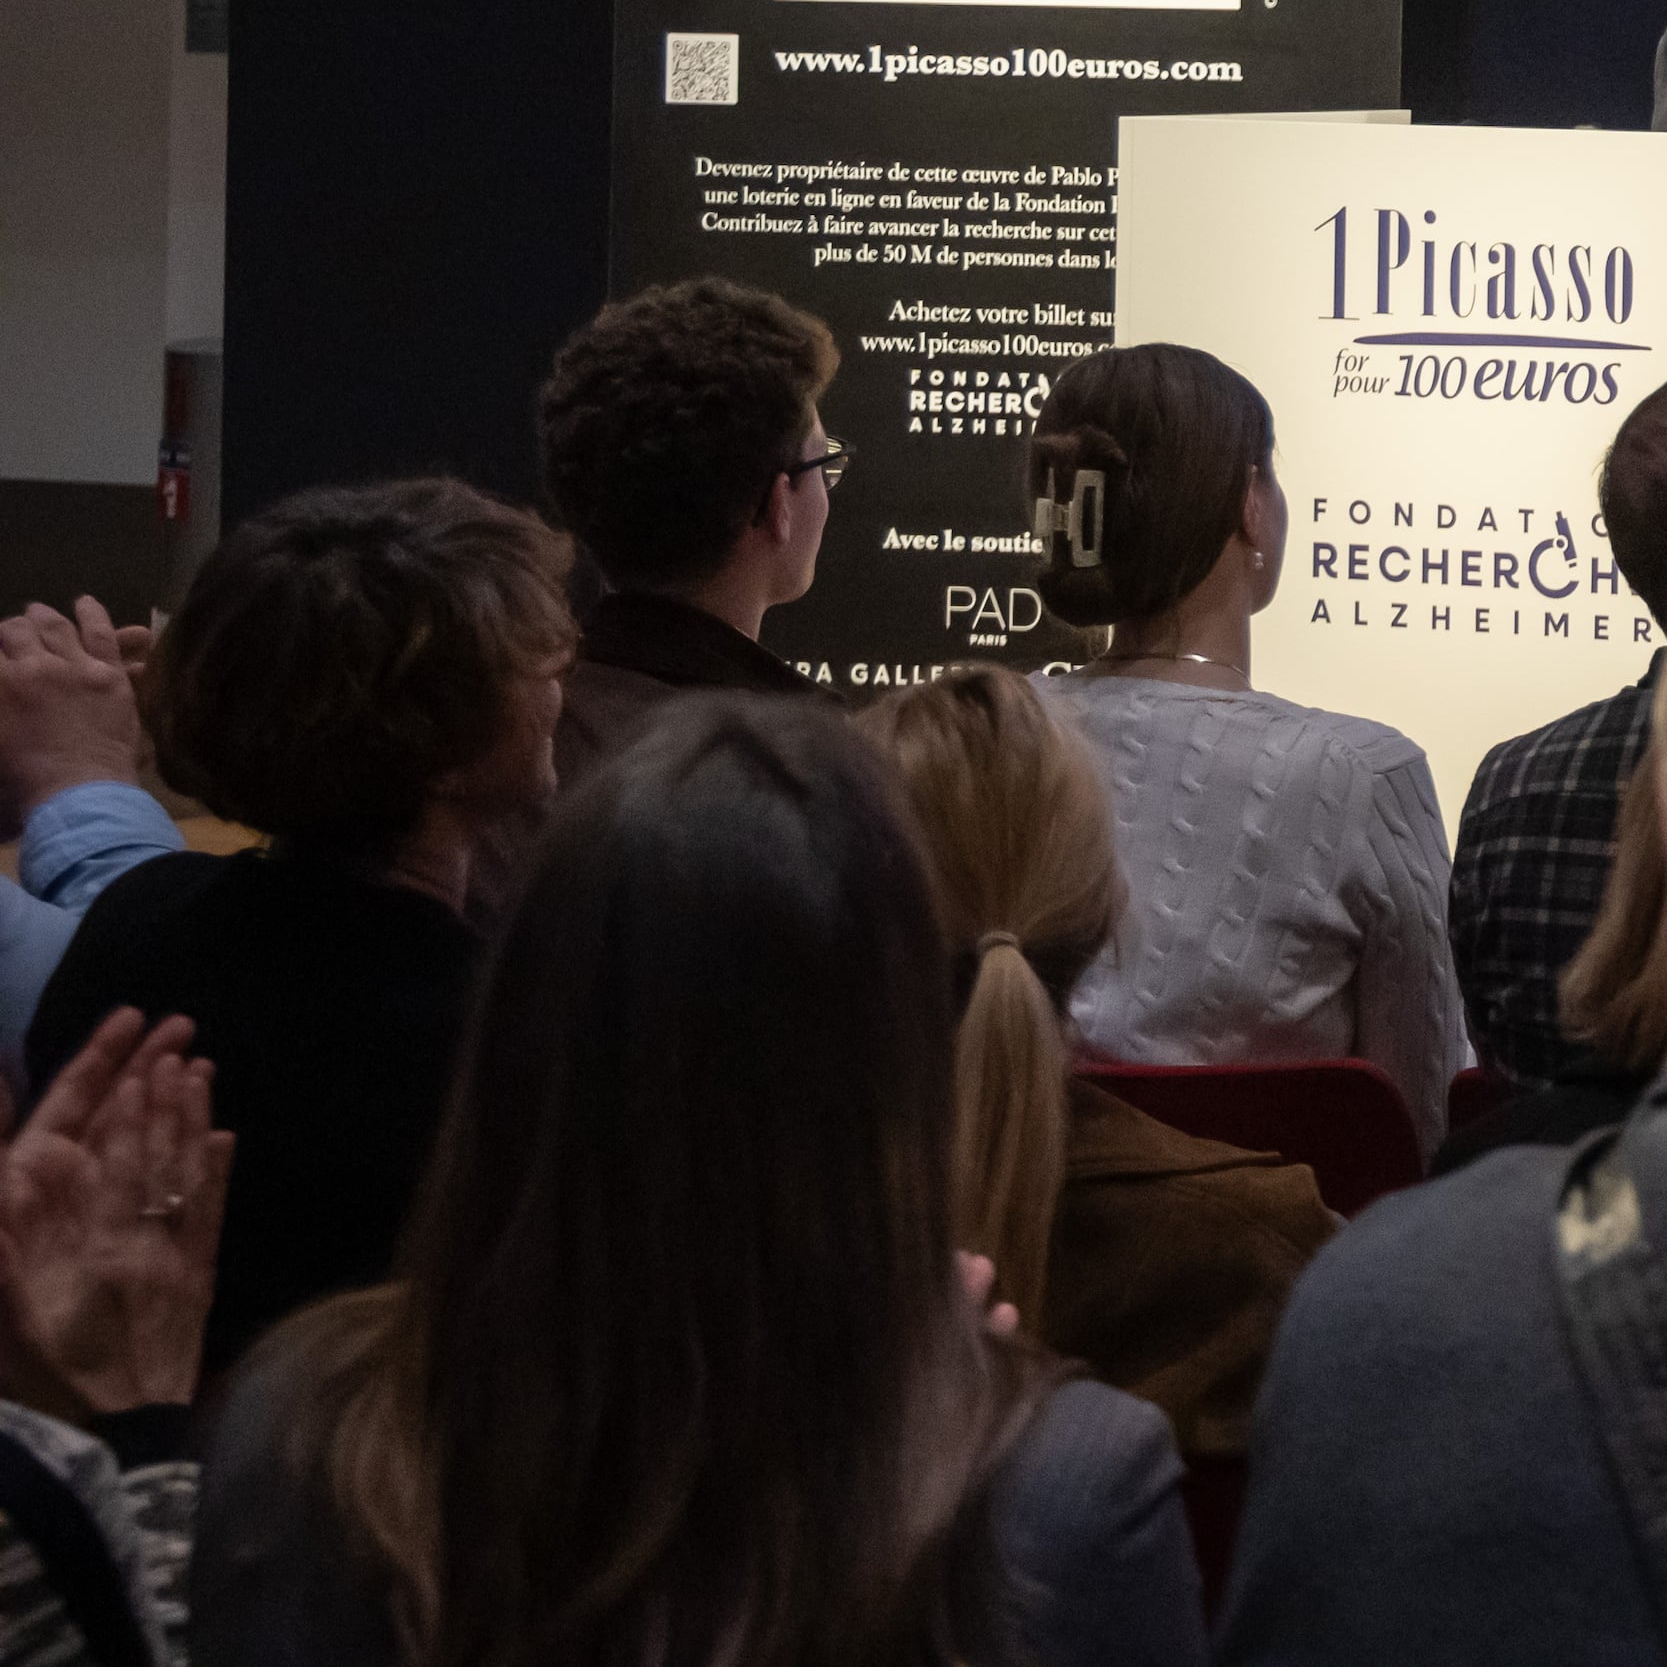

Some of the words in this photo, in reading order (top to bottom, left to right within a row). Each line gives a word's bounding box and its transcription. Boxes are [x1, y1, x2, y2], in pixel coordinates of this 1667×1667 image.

[774, 45, 1244, 82] www.1picasso100euros.com
[695, 156, 773, 178] Devenez
[777, 160, 884, 184] propriétaire
[887, 162, 910, 182] de
[914, 167, 958, 183] cette
[962, 169, 1020, 184] œuvre
[1024, 165, 1046, 184] de
[1051, 166, 1103, 186] Pablo
[704, 190, 738, 205] une
[742, 186, 800, 206] loterie
[804, 192, 826, 207] en
[830, 188, 875, 212] ligne
[879, 194, 902, 209] en
[906, 190, 963, 210] faveur
[966, 192, 989, 211] de
[993, 192, 1011, 212] la
[1014, 192, 1106, 214] Fondation
[701, 212, 804, 233] Contribuez
[807, 214, 820, 234] à
[824, 215, 864, 235] faire
[868, 222, 940, 237] avancer
[943, 218, 960, 238] la
[964, 219, 1052, 239] recherche
[1056, 226, 1086, 241] sur
[814, 242, 852, 267] plus
[855, 243, 879, 263] de
[882, 244, 906, 264] 50
[910, 244, 933, 264] M
[936, 246, 959, 266] de
[962, 251, 1054, 271] personnes
[1057, 249, 1100, 269] dans
[888, 300, 972, 324] Achetez
[976, 305, 1029, 325] votre
[1034, 303, 1086, 327] billet
[1090, 308, 1116, 327] su
[1333, 348, 1370, 376] for
[1333, 374, 1390, 398] pour
[882, 527, 939, 551] Avec
[943, 528, 969, 552] le
[970, 531, 1043, 554] soutie
[1312, 538, 1640, 599] RECHERCH
[945, 585, 1043, 632] PAD
[1311, 599, 1652, 643] ALZHEIMER
[969, 634, 1008, 647] PARIS
